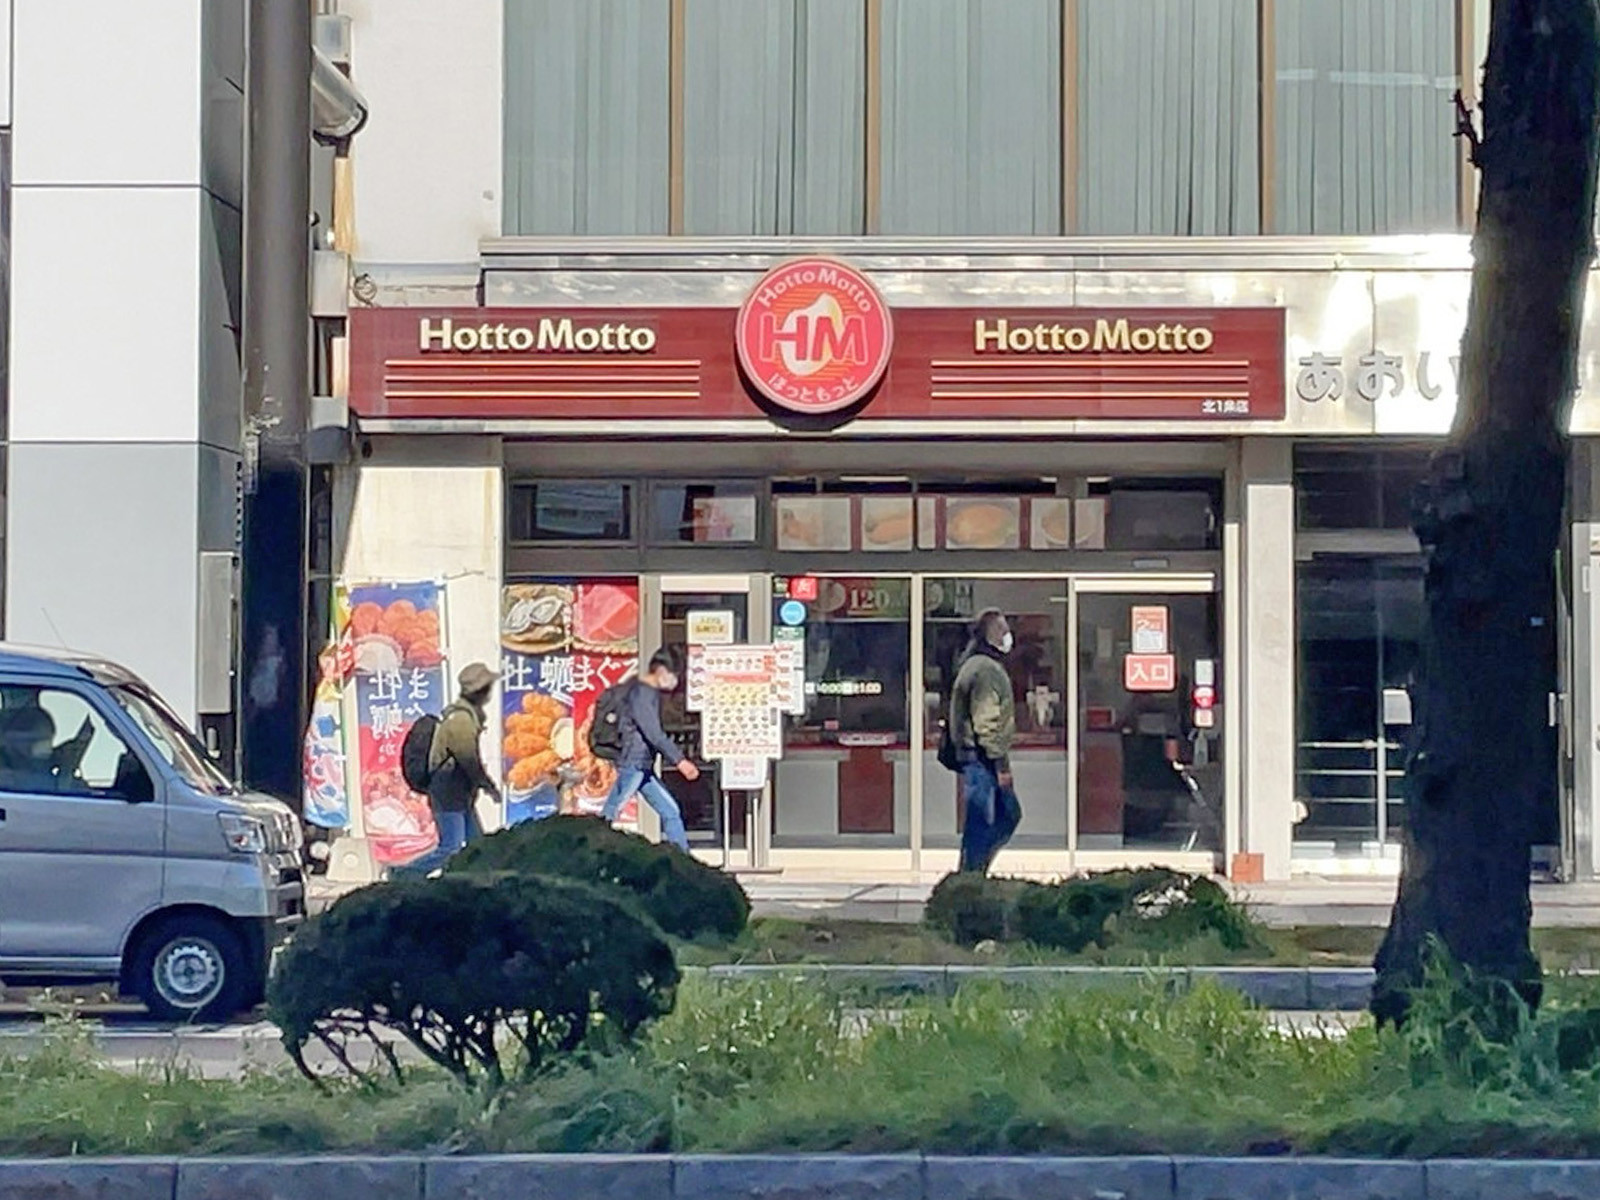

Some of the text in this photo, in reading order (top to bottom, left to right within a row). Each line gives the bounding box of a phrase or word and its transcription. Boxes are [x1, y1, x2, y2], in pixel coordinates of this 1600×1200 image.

[759, 312, 869, 366] HM
[768, 372, 859, 403] ほっともっと
[1130, 662, 1169, 682] 入口
